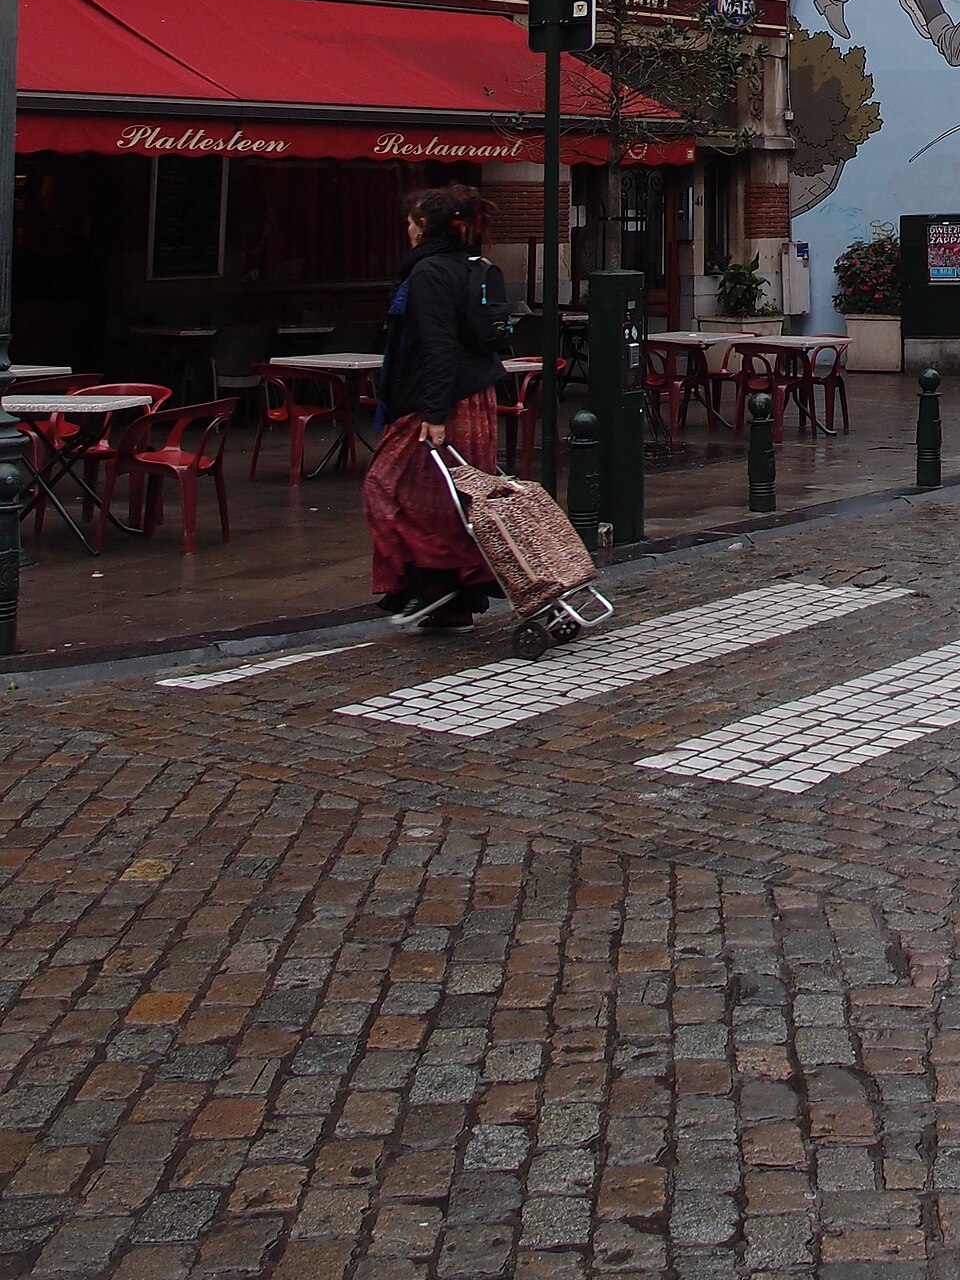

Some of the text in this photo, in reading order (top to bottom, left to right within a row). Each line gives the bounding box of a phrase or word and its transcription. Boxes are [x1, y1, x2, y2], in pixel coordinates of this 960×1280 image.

[116, 123, 292, 153] Plattesteen
[373, 131, 524, 159] Restaurant
[694, 195, 703, 206] 41
